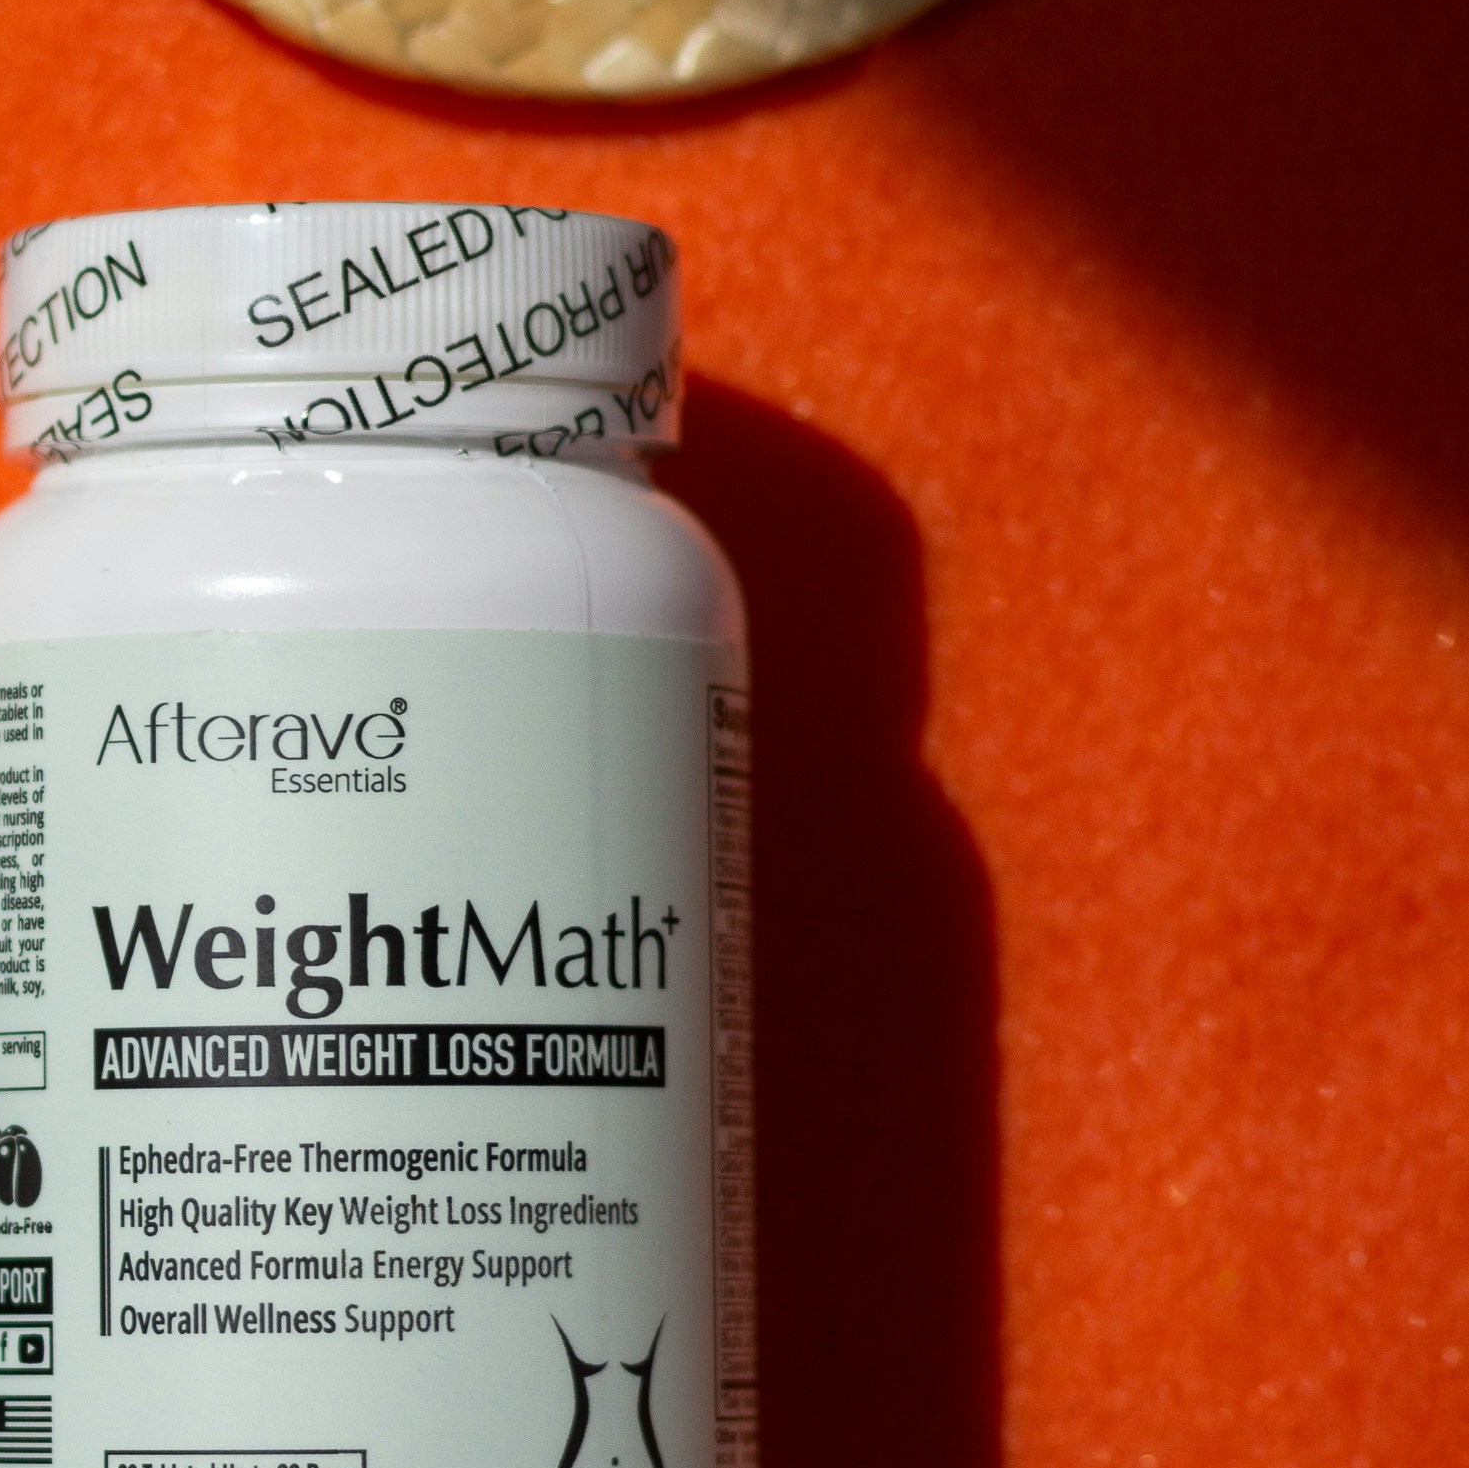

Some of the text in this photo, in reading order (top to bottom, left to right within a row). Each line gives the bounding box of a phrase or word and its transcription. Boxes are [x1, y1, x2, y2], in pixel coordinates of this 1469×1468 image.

[246, 206, 495, 350] SEALED
[259, 263, 625, 456] PROTECTION
[30, 684, 44, 698] or
[32, 702, 44, 719] in
[3, 724, 29, 743] used
[32, 723, 44, 740] in
[32, 765, 44, 782] in
[271, 765, 407, 794] Essentials
[32, 786, 45, 803] of
[2, 810, 45, 830] nursing
[31, 853, 45, 868] or
[19, 870, 45, 893] high
[0, 892, 44, 912] disease,
[1, 914, 45, 932] or have
[18, 936, 45, 957] your
[35, 955, 45, 972] is
[22, 979, 45, 998] soy,
[1, 1037, 41, 1059] serving
[101, 1032, 657, 1080] ADVANCED WEIGHT LOSS FORMULA
[119, 1140, 587, 1184] Ephedra-Free Thermogenic Formula
[120, 1193, 641, 1237] High Quality Key Weight Loss Ingredients
[118, 1248, 574, 1288] Advanced Formula Energy Support
[120, 1302, 456, 1342] Overall Wellness Support
